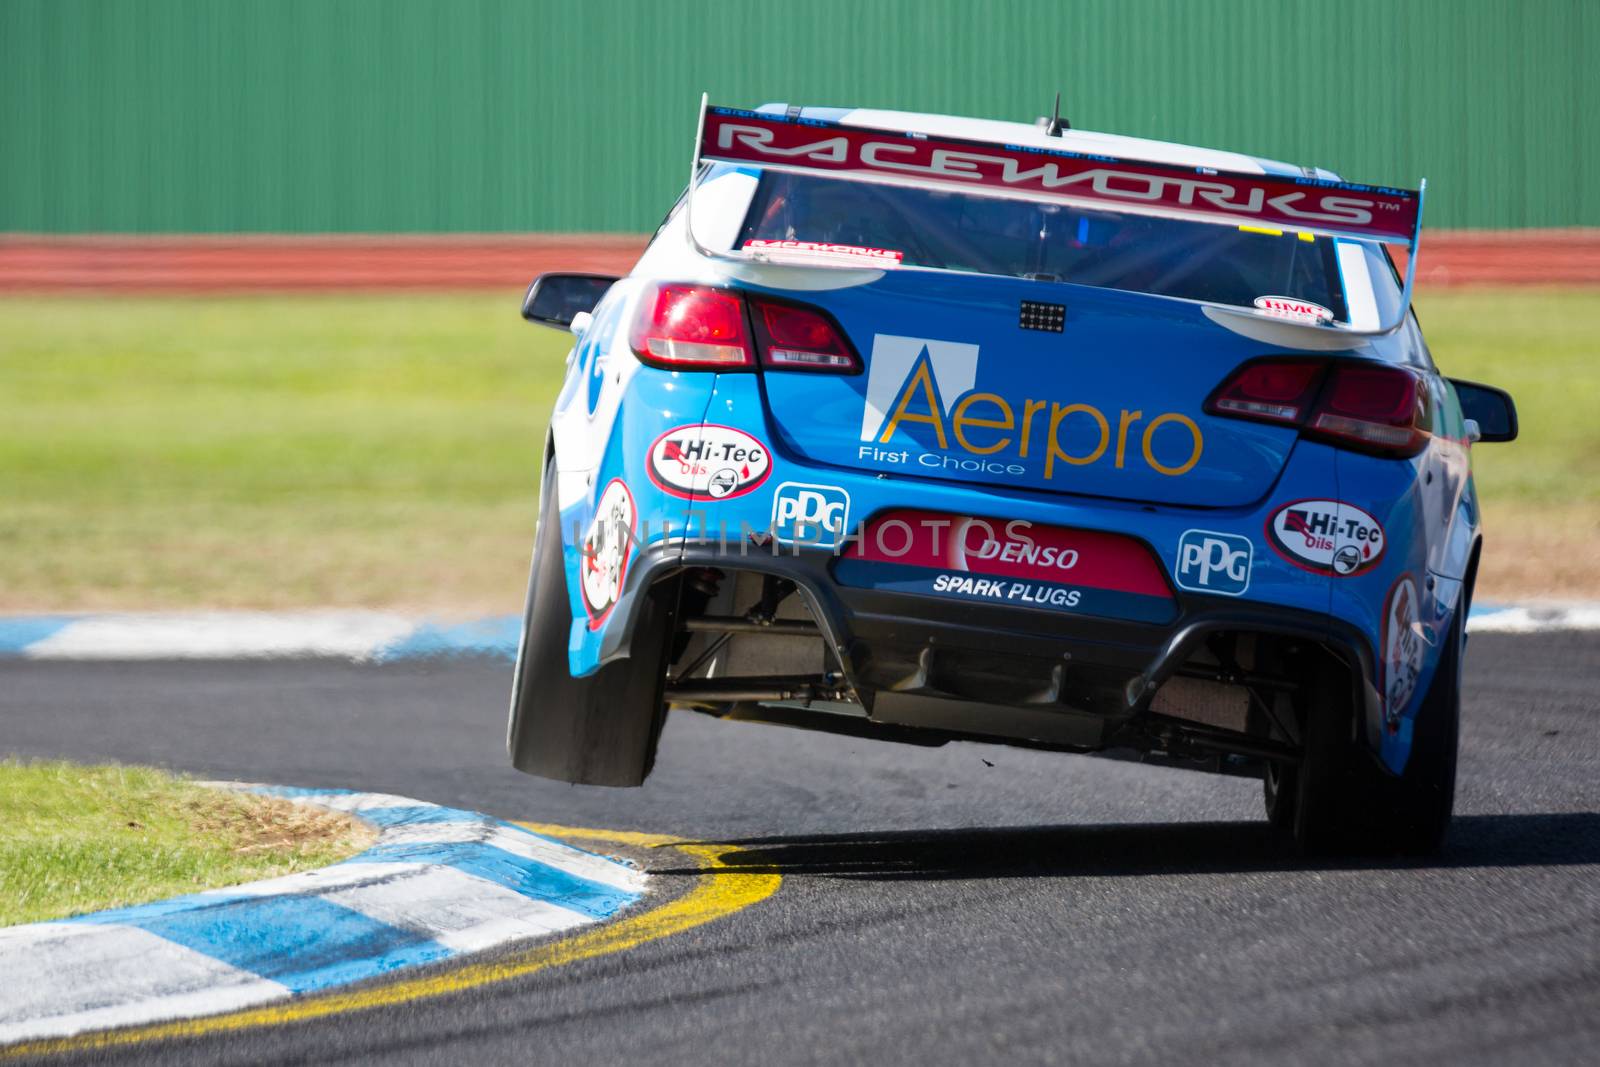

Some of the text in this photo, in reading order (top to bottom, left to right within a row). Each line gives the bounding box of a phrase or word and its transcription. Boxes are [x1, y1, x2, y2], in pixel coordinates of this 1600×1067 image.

[717, 123, 1373, 225] RACEWORKS
[879, 357, 1204, 480] Aerpro
[685, 439, 762, 463] Hi-Tec
[858, 446, 1026, 475] First Choice
[777, 490, 844, 538] PPG
[1309, 512, 1380, 543] Hi-Tec
[978, 539, 1079, 570] DENSO
[1305, 534, 1334, 551] Oils
[1180, 537, 1248, 586] PPG
[933, 574, 1082, 607] SPARK PLUGS
